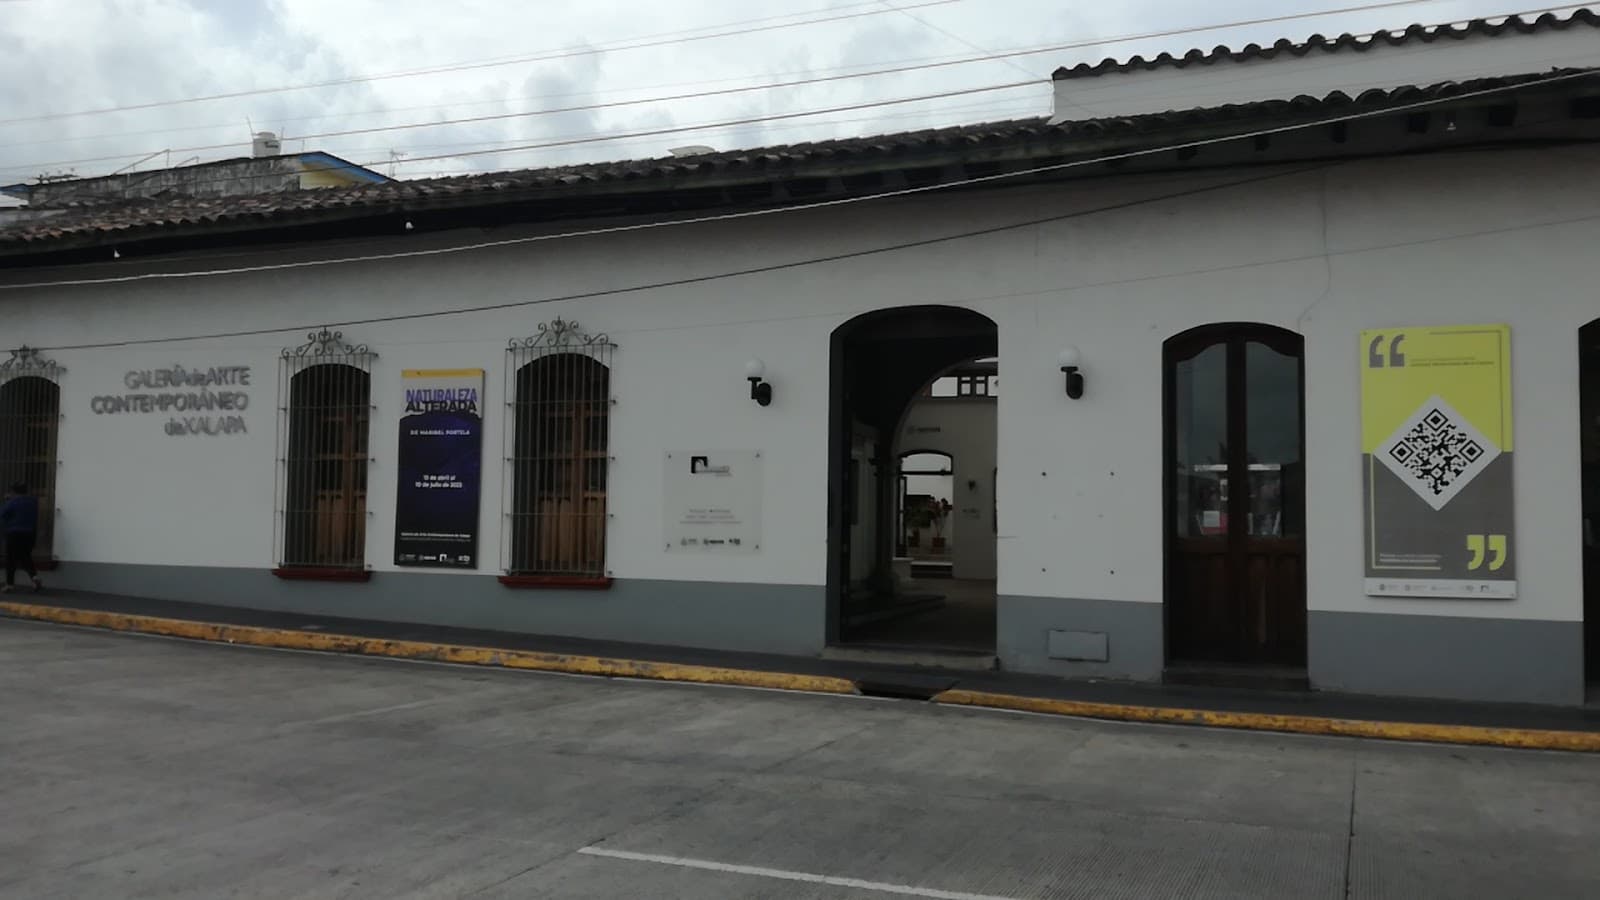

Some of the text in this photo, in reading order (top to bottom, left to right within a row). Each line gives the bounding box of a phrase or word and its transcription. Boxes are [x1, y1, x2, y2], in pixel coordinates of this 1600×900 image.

[91, 387, 249, 414] CONTEMPORÁNEO
[406, 388, 477, 402] NATURALEZA
[405, 400, 477, 412] ALTERADA
